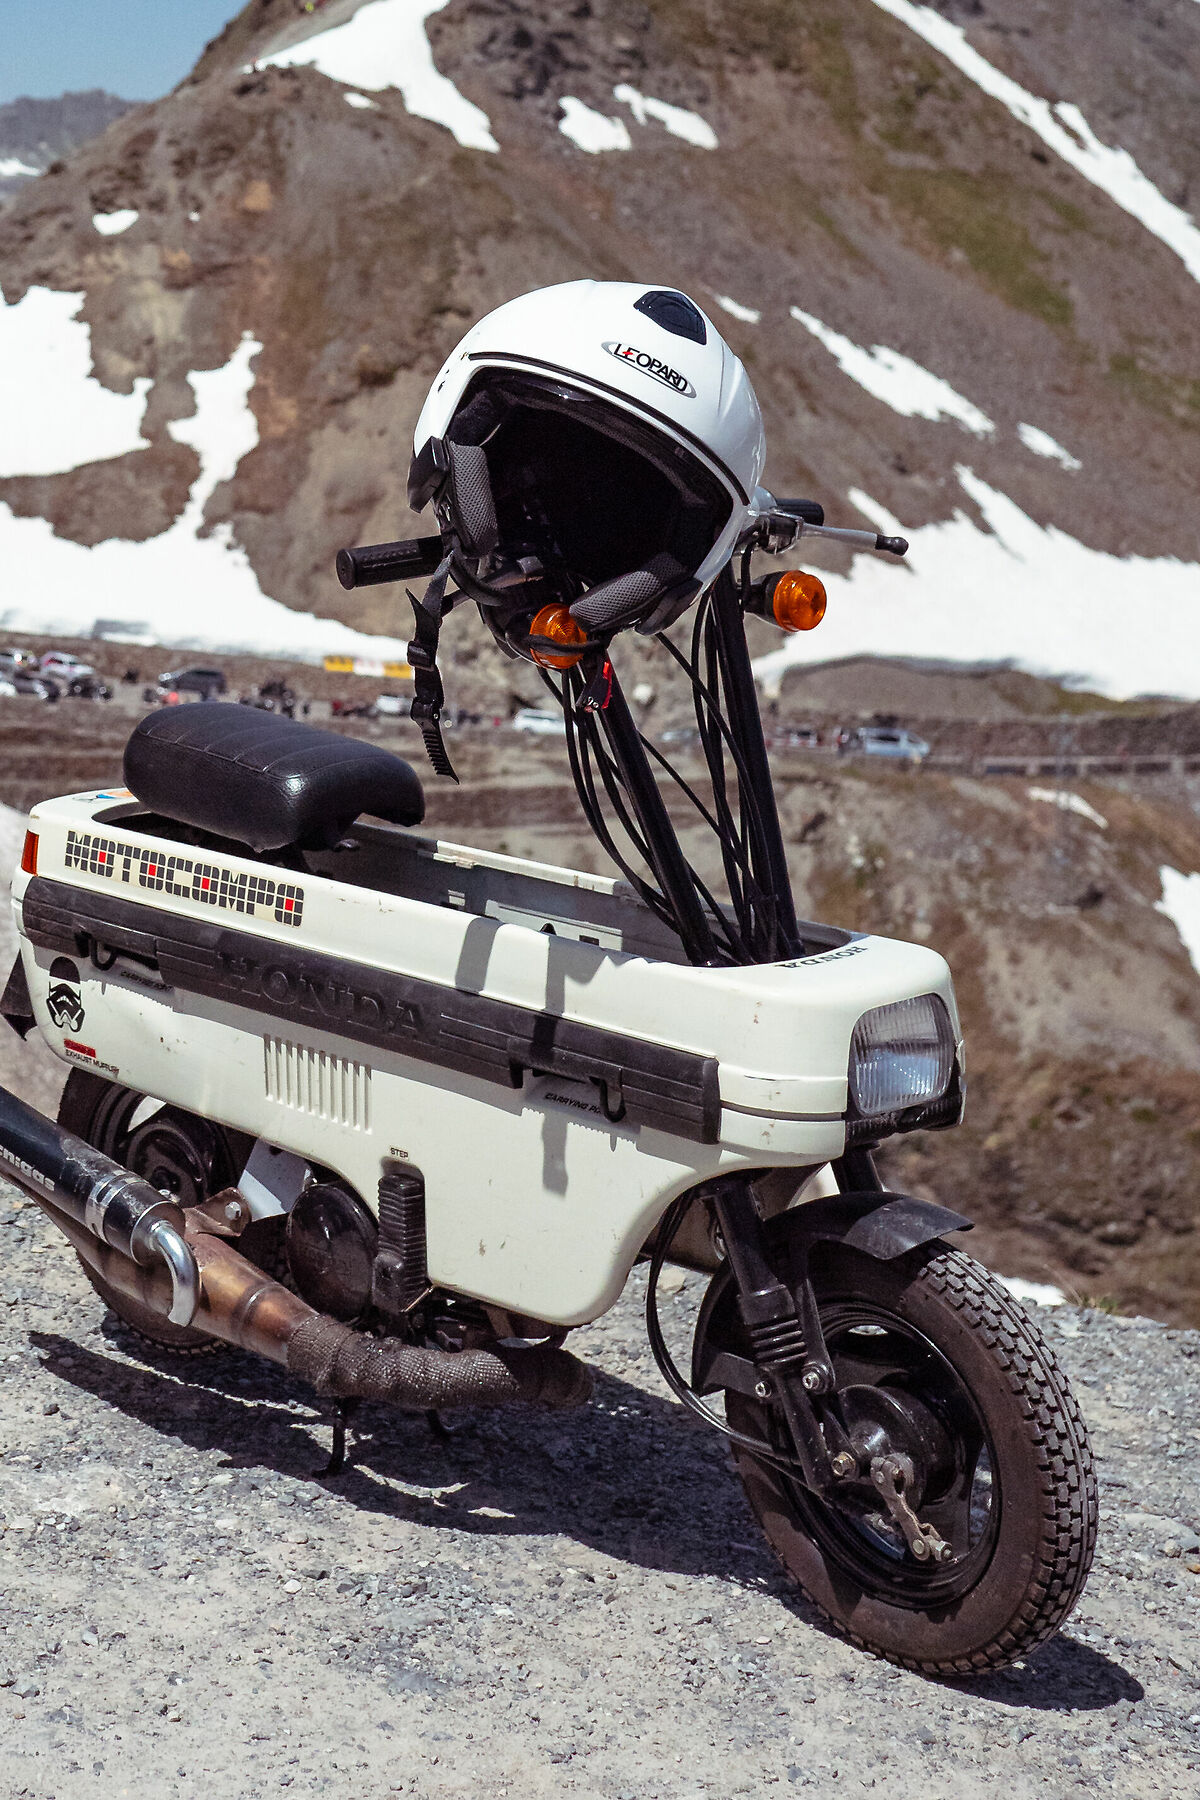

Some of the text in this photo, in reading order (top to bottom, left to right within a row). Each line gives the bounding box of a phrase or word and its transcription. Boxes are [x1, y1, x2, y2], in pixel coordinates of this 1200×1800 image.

[613, 343, 688, 392] LEOPARD
[64, 830, 305, 928] MOTOCOMPO
[213, 950, 441, 1048] HONDA
[545, 1092, 588, 1110] CARRYING
[390, 1147, 409, 1158] STEP
